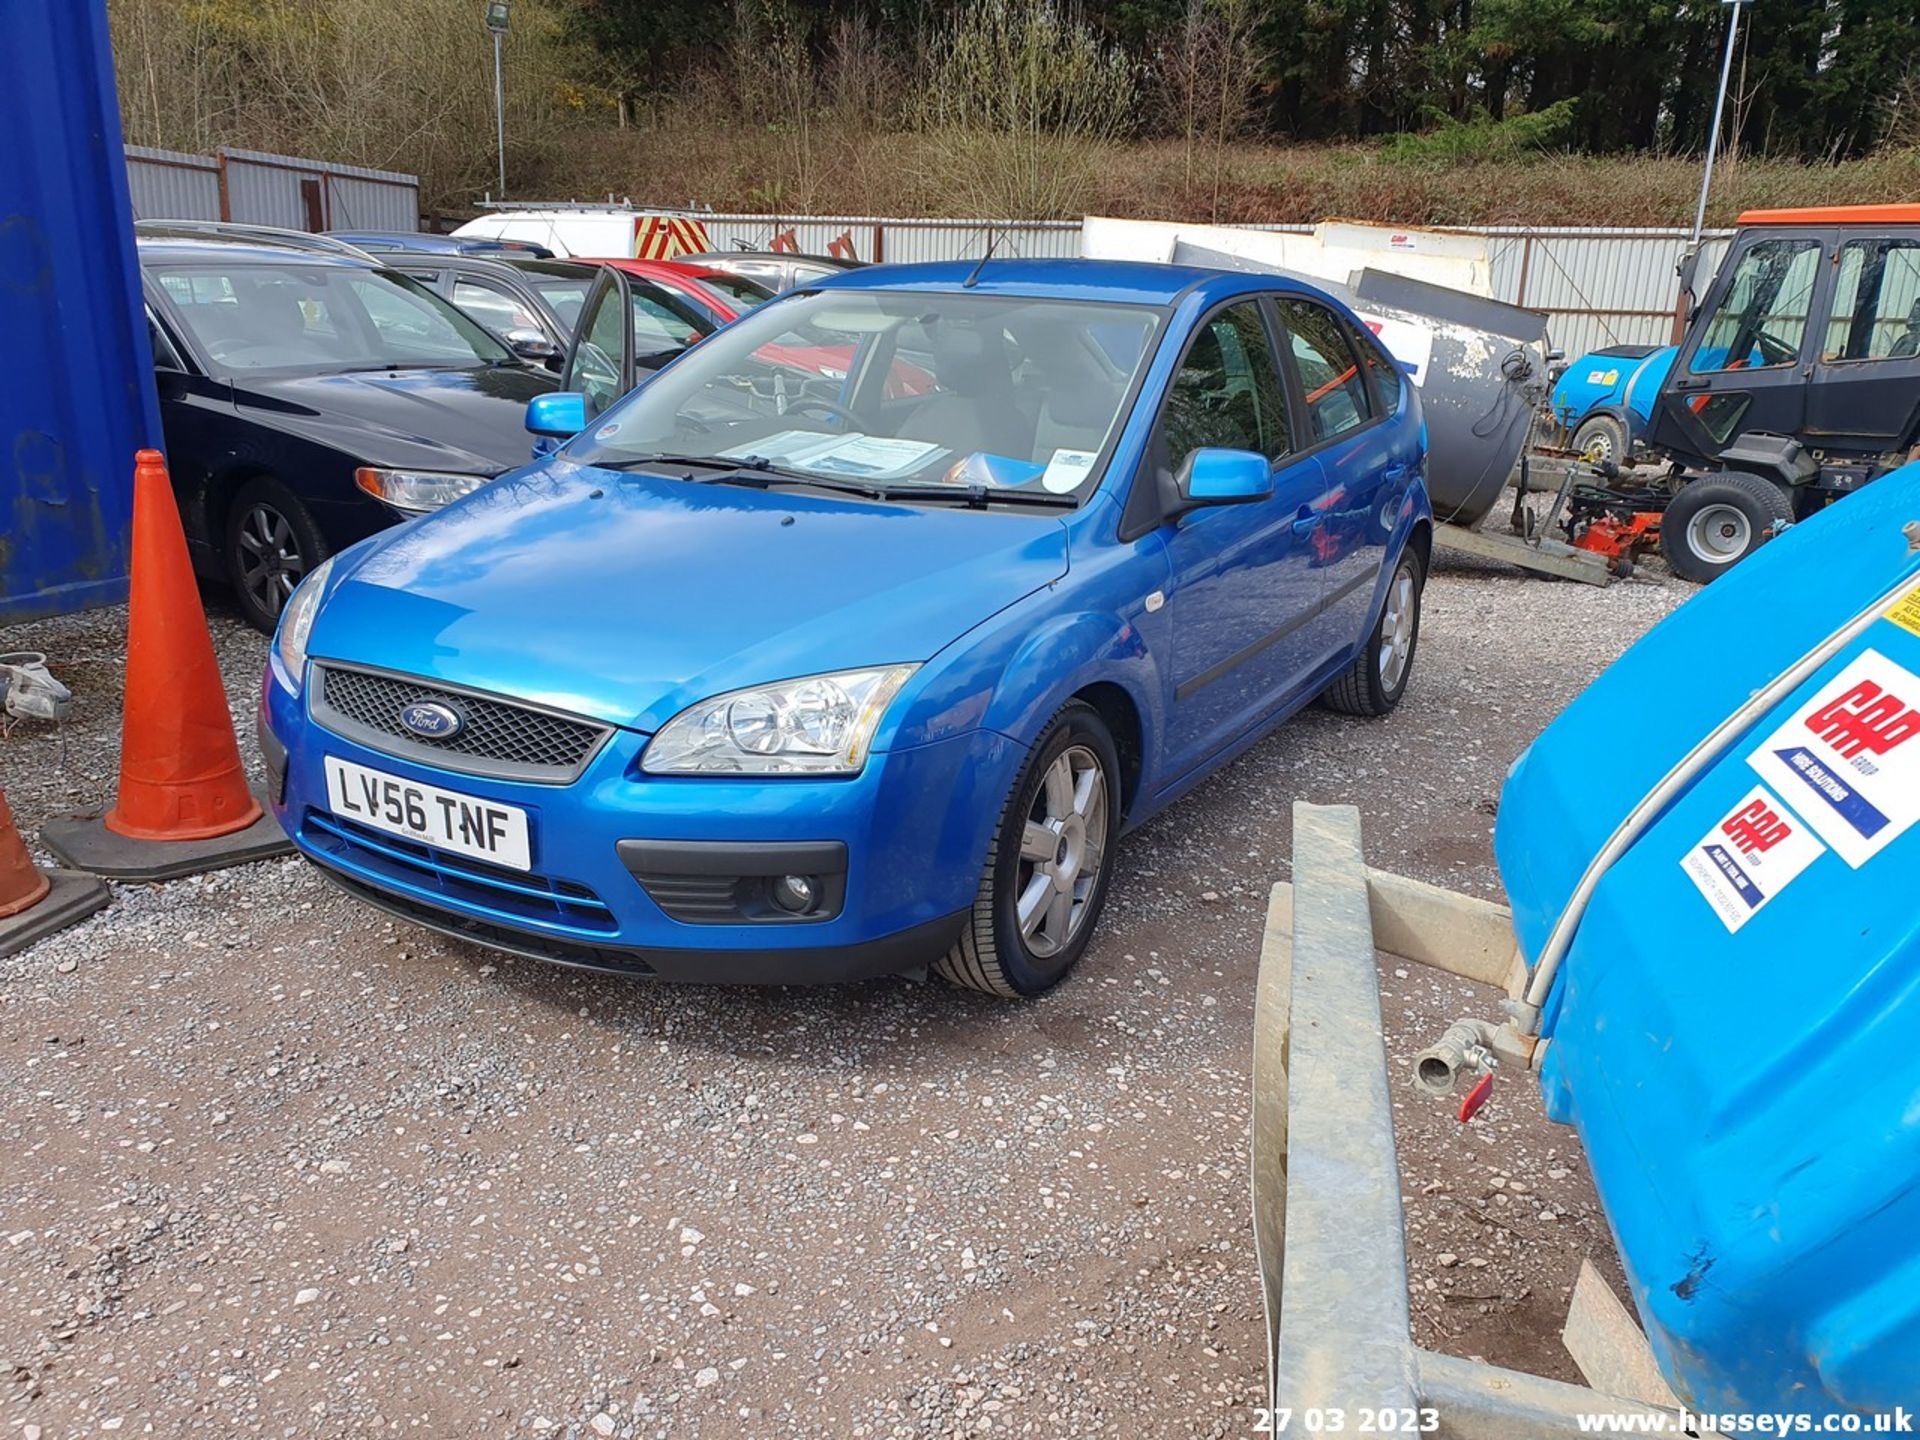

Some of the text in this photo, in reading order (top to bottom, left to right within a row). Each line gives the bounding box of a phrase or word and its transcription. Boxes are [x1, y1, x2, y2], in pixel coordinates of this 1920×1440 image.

[408, 708, 441, 731] Ford
[1790, 751, 1849, 802] HIRE SOLUTIONS
[1850, 755, 1879, 776] GROUP
[339, 767, 509, 852] LV56 TNF
